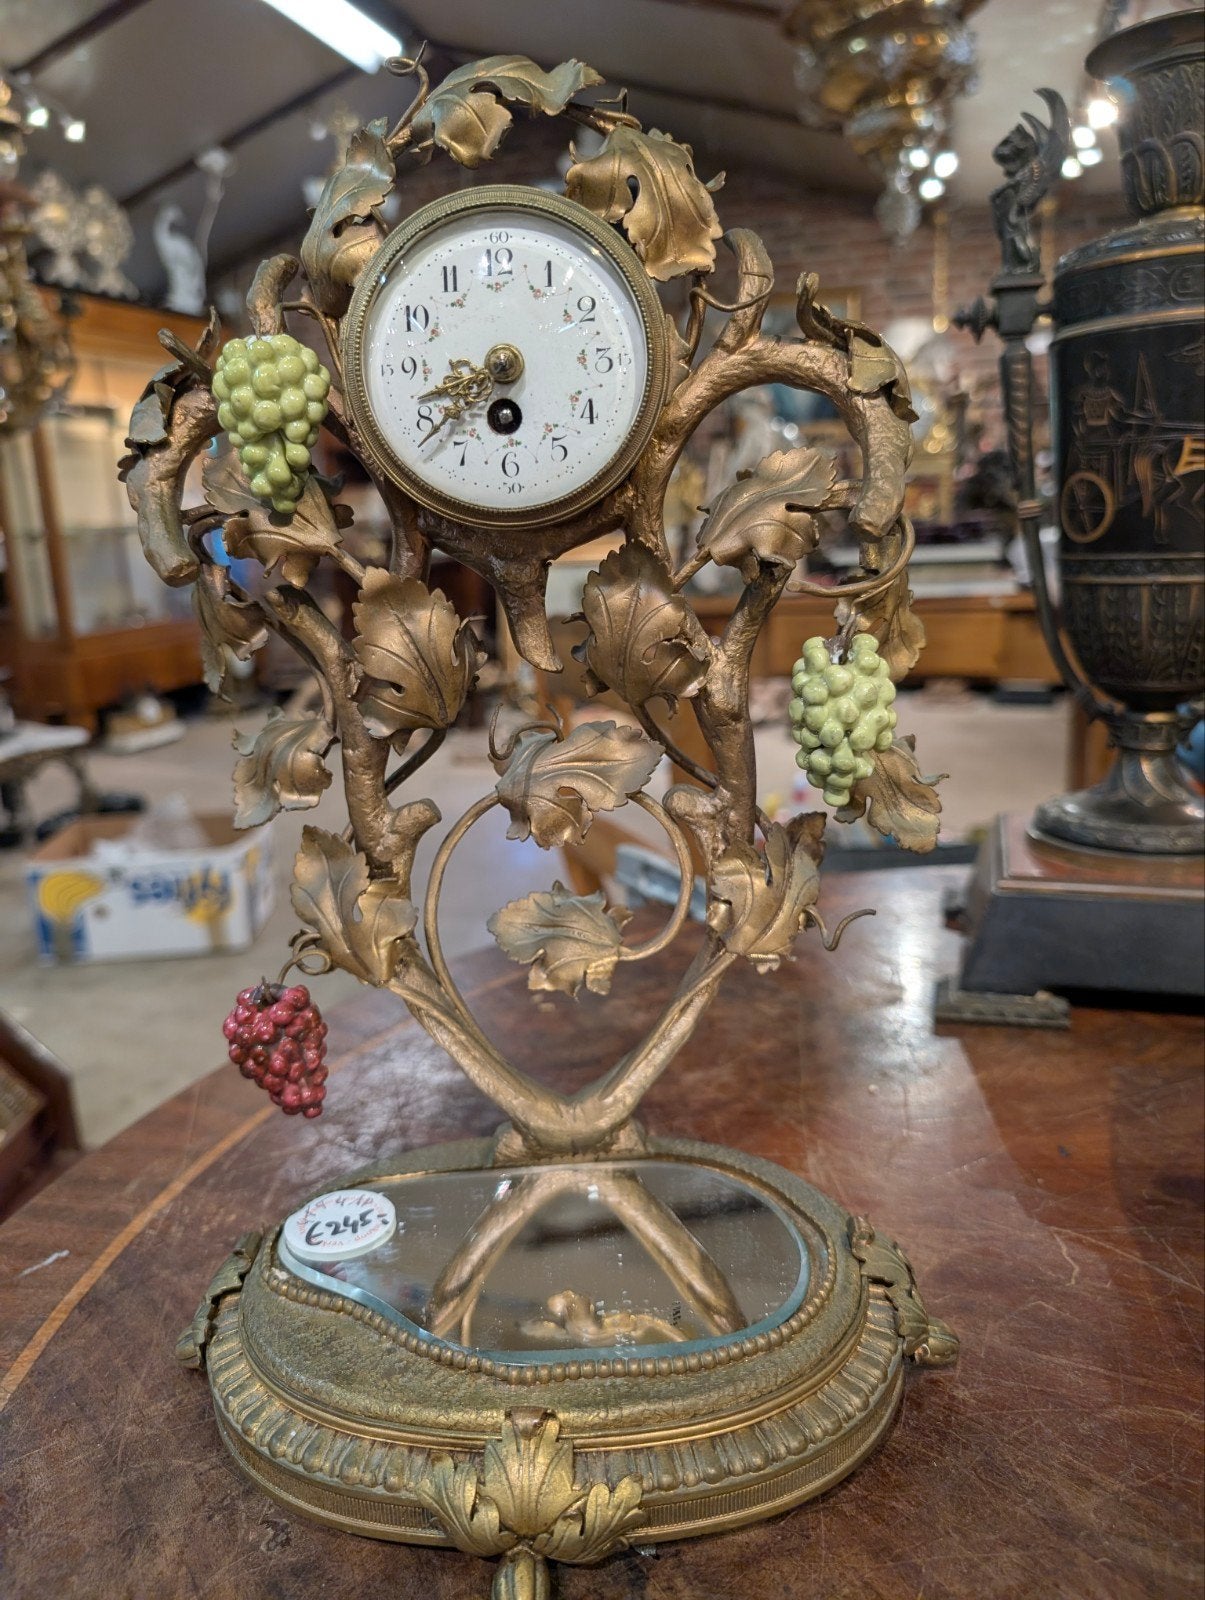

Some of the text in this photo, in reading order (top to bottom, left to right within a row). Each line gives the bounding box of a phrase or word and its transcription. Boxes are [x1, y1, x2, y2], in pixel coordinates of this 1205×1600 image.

[489, 231, 509, 243] 60
[484, 248, 513, 276] 12
[544, 260, 552, 287] 1
[442, 265, 458, 292] 11
[405, 305, 429, 332] 10
[577, 296, 596, 322] 2
[401, 356, 417, 380] 9
[595, 347, 614, 373] 3
[618, 353, 631, 366] 15
[416, 405, 434, 432] 8
[580, 398, 598, 424] 4
[453, 441, 469, 466] 7
[550, 435, 568, 462] 5
[501, 452, 520, 478] 6
